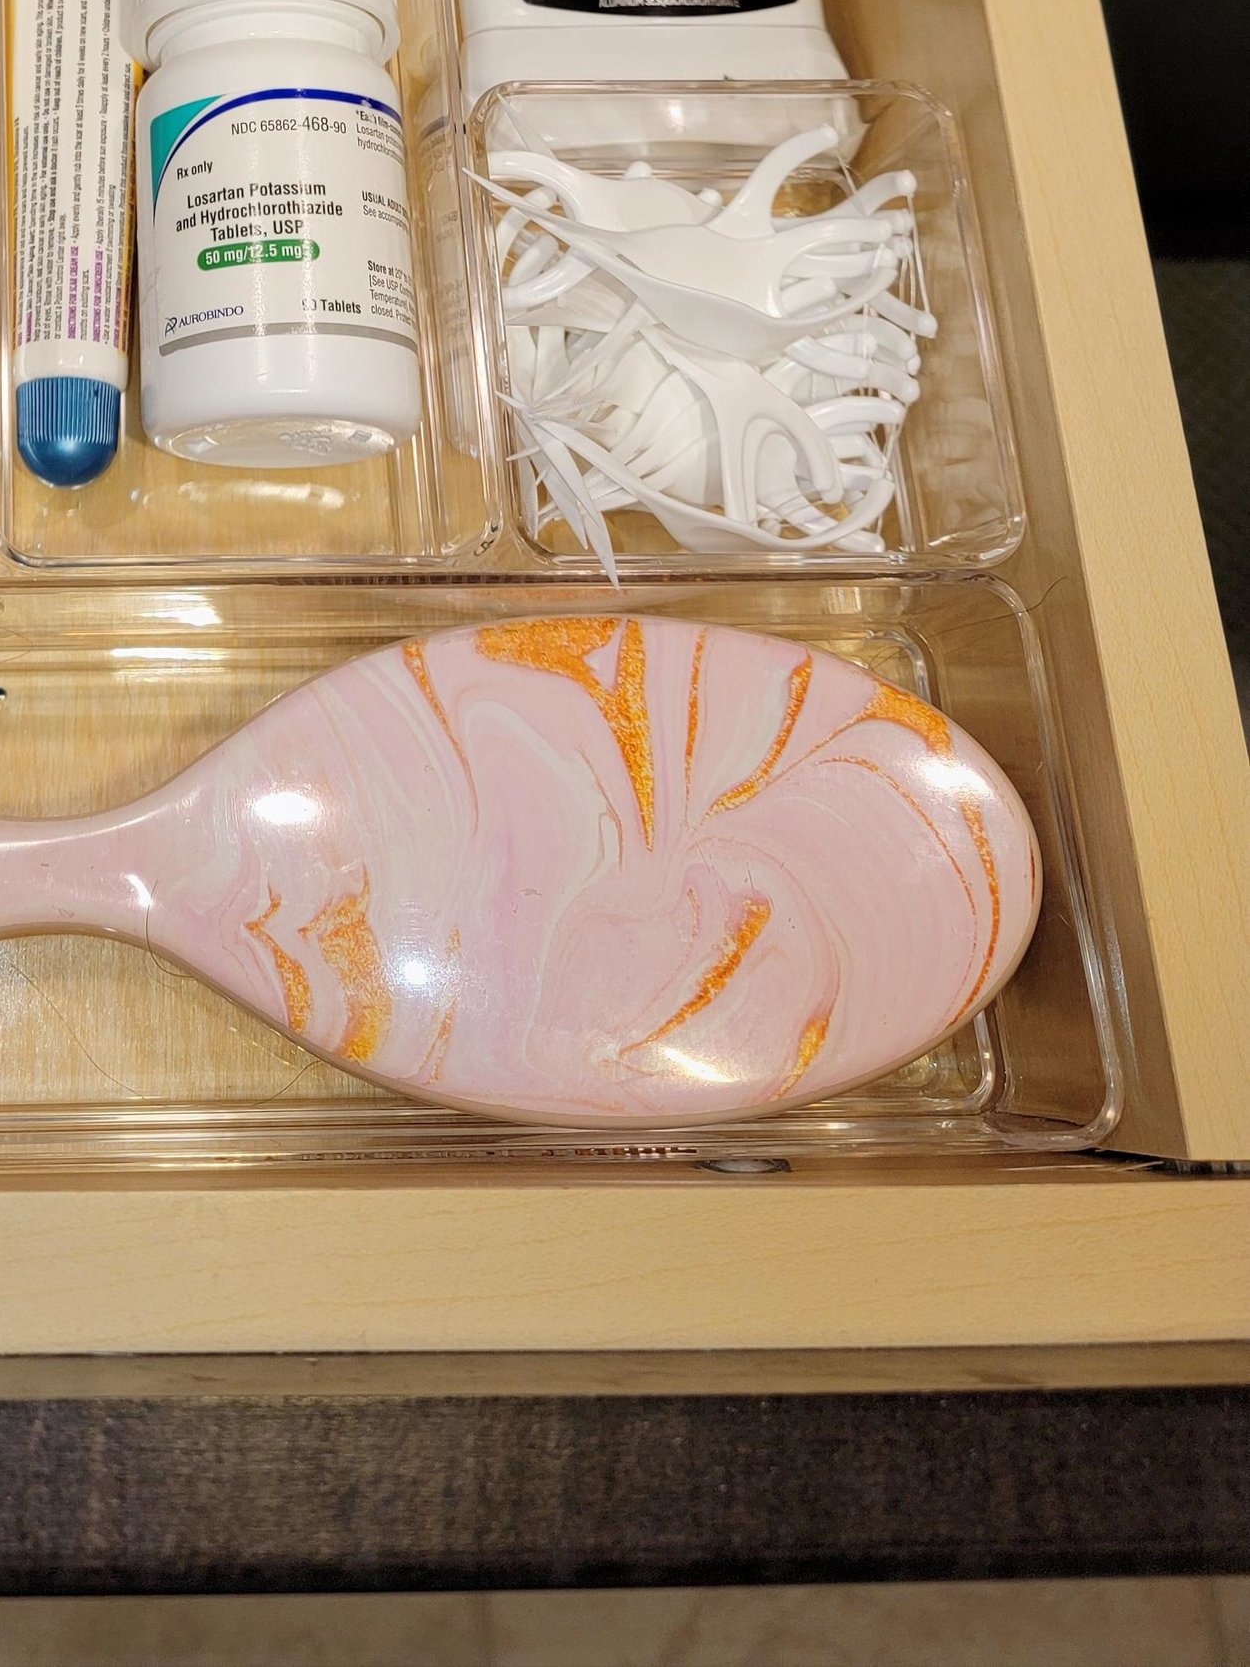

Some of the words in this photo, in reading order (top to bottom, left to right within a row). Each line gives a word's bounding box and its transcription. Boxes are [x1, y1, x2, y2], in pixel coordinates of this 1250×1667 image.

[231, 121, 257, 136] NDC
[177, 167, 190, 180] Rx
[191, 160, 214, 178] only
[187, 187, 245, 210] Losartan
[176, 213, 197, 232] and
[200, 200, 344, 227] Hydrochlorothiazide
[363, 204, 377, 218] See
[210, 222, 268, 242] Tablets,
[273, 220, 305, 235] USP
[70, 245, 79, 257] USE
[205, 248, 221, 266] 50
[69, 258, 79, 277] CREAM
[367, 260, 387, 275] Store
[69, 278, 78, 292] SCAR
[69, 293, 78, 305] FOR
[320, 299, 362, 315] Tablets
[67, 306, 77, 340] DIRECTIONS
[178, 306, 245, 328] AUROBINDO
